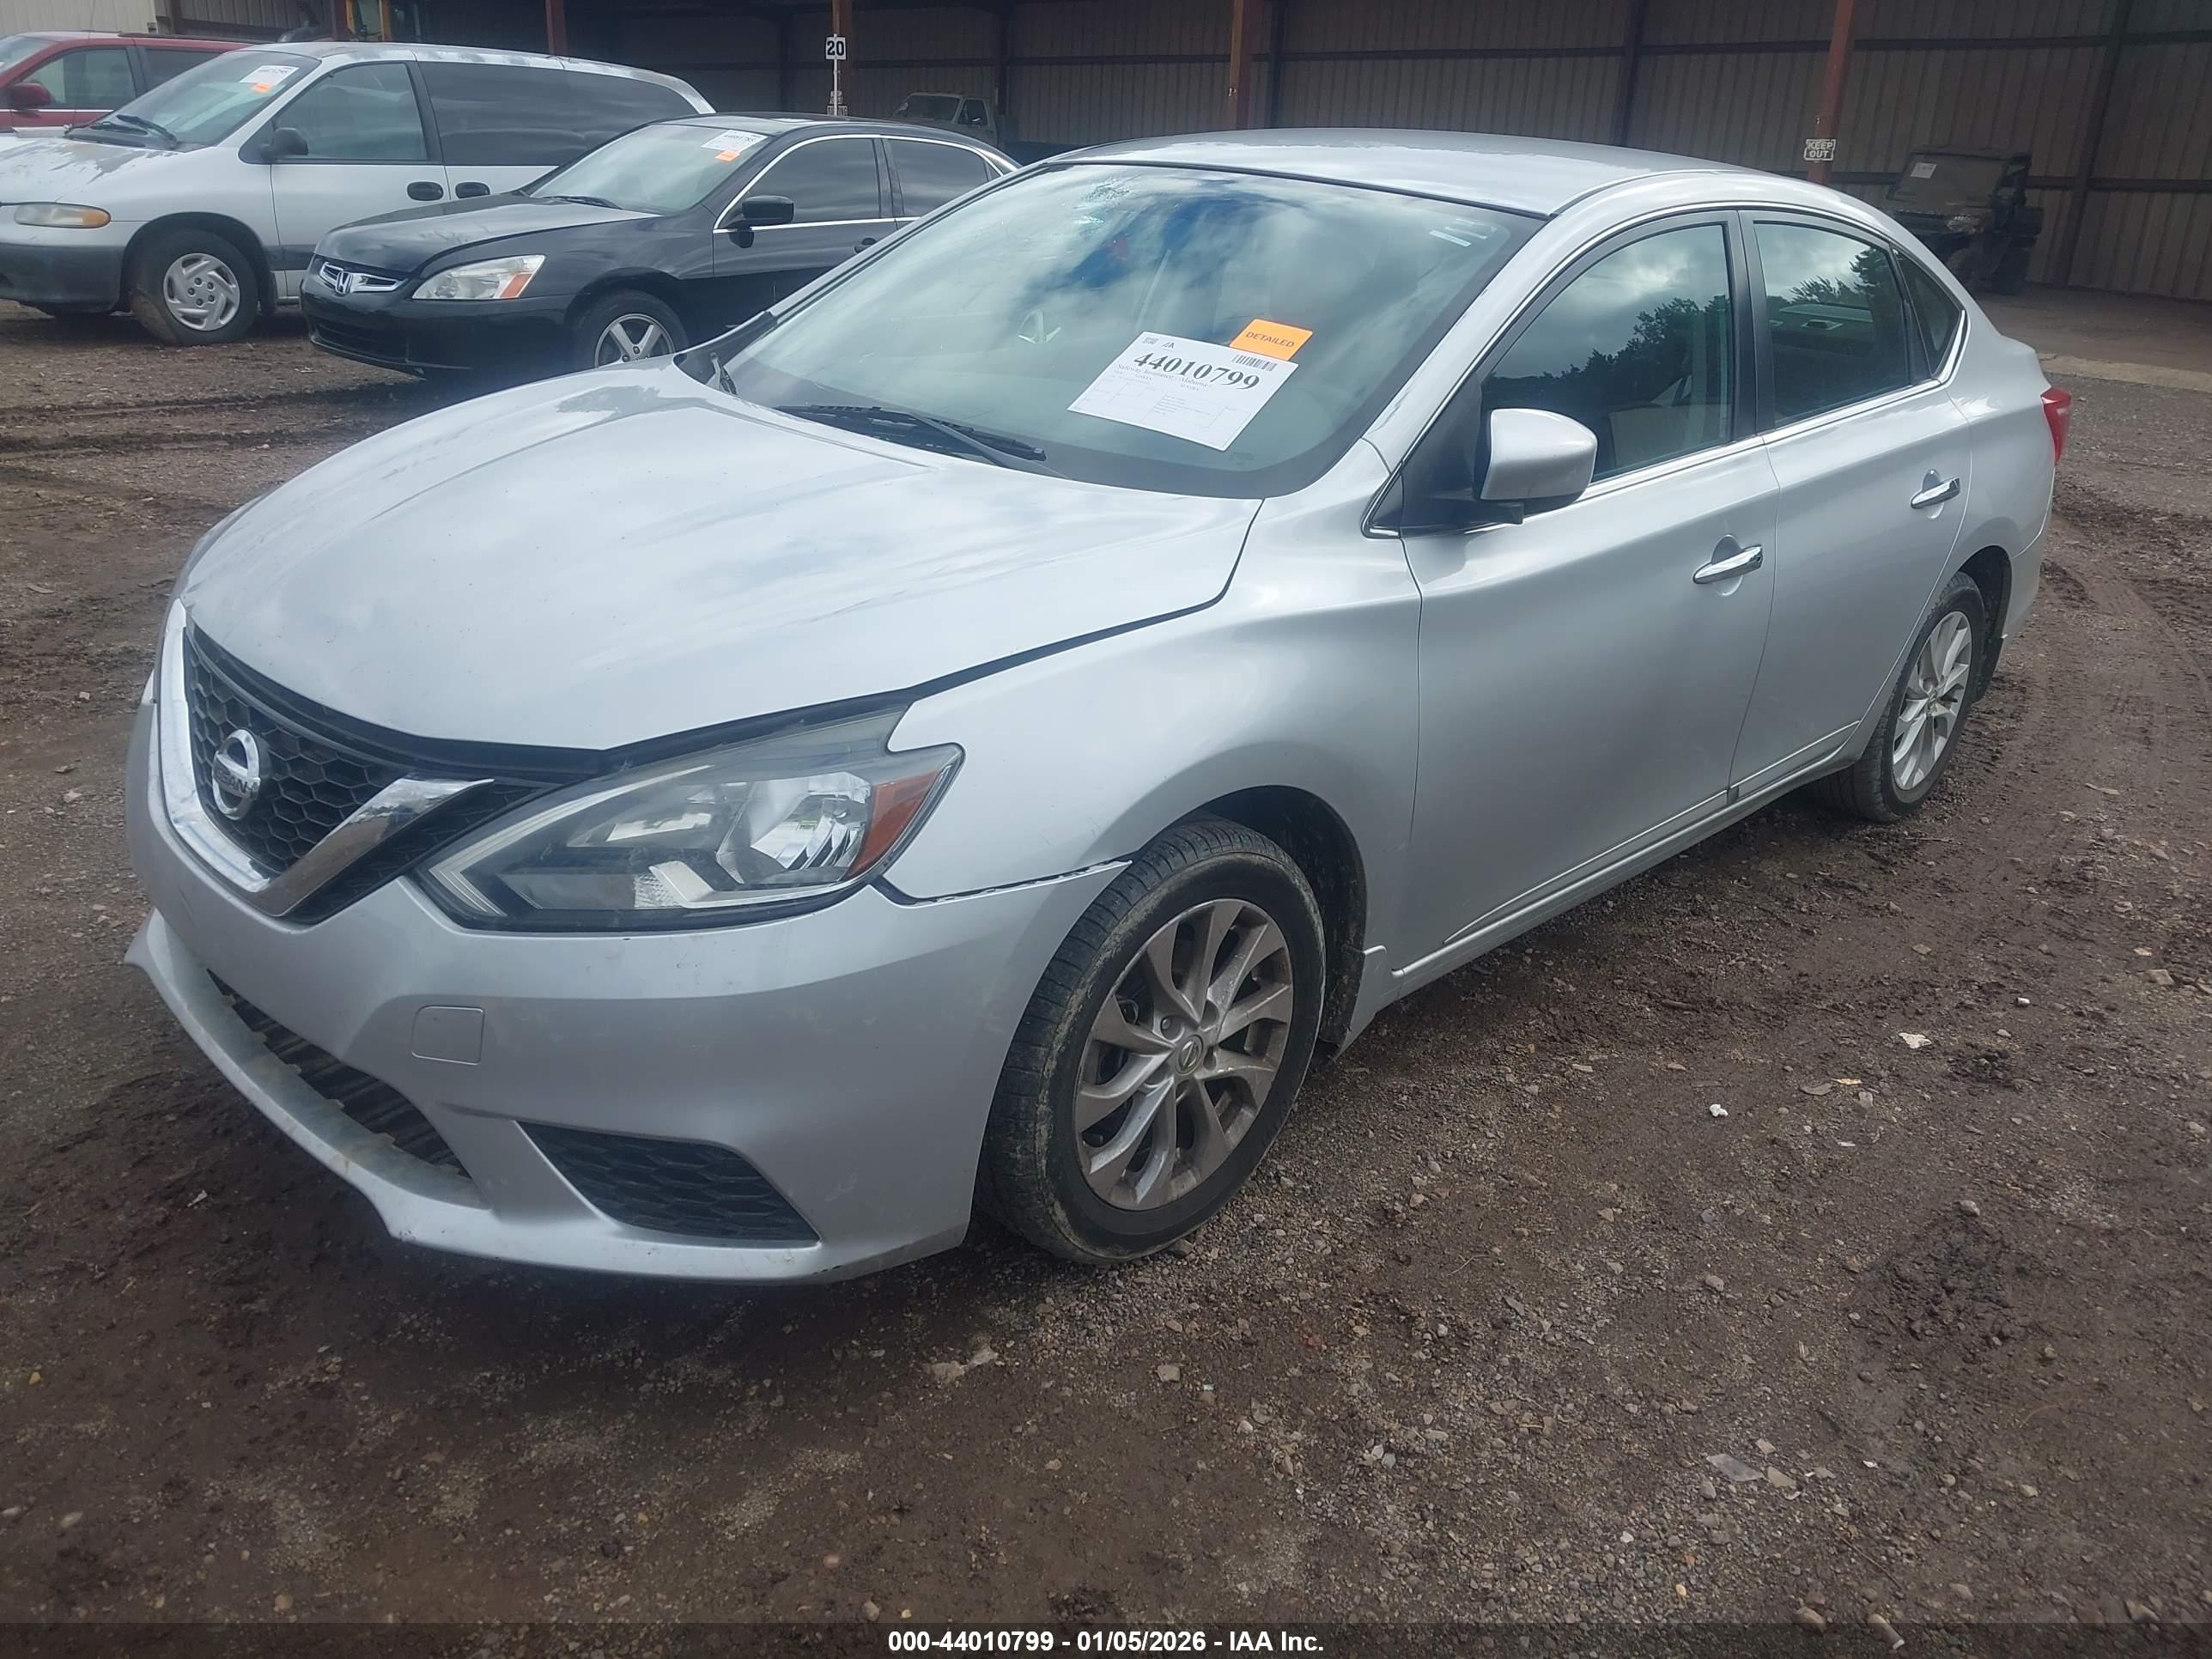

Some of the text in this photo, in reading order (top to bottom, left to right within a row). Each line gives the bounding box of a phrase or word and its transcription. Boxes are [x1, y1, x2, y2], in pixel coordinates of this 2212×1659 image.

[827, 40, 844, 56] 20
[1807, 141, 1833, 150] KEEP
[1245, 331, 1295, 348] DETAILED
[1133, 353, 1260, 389] 44010799
